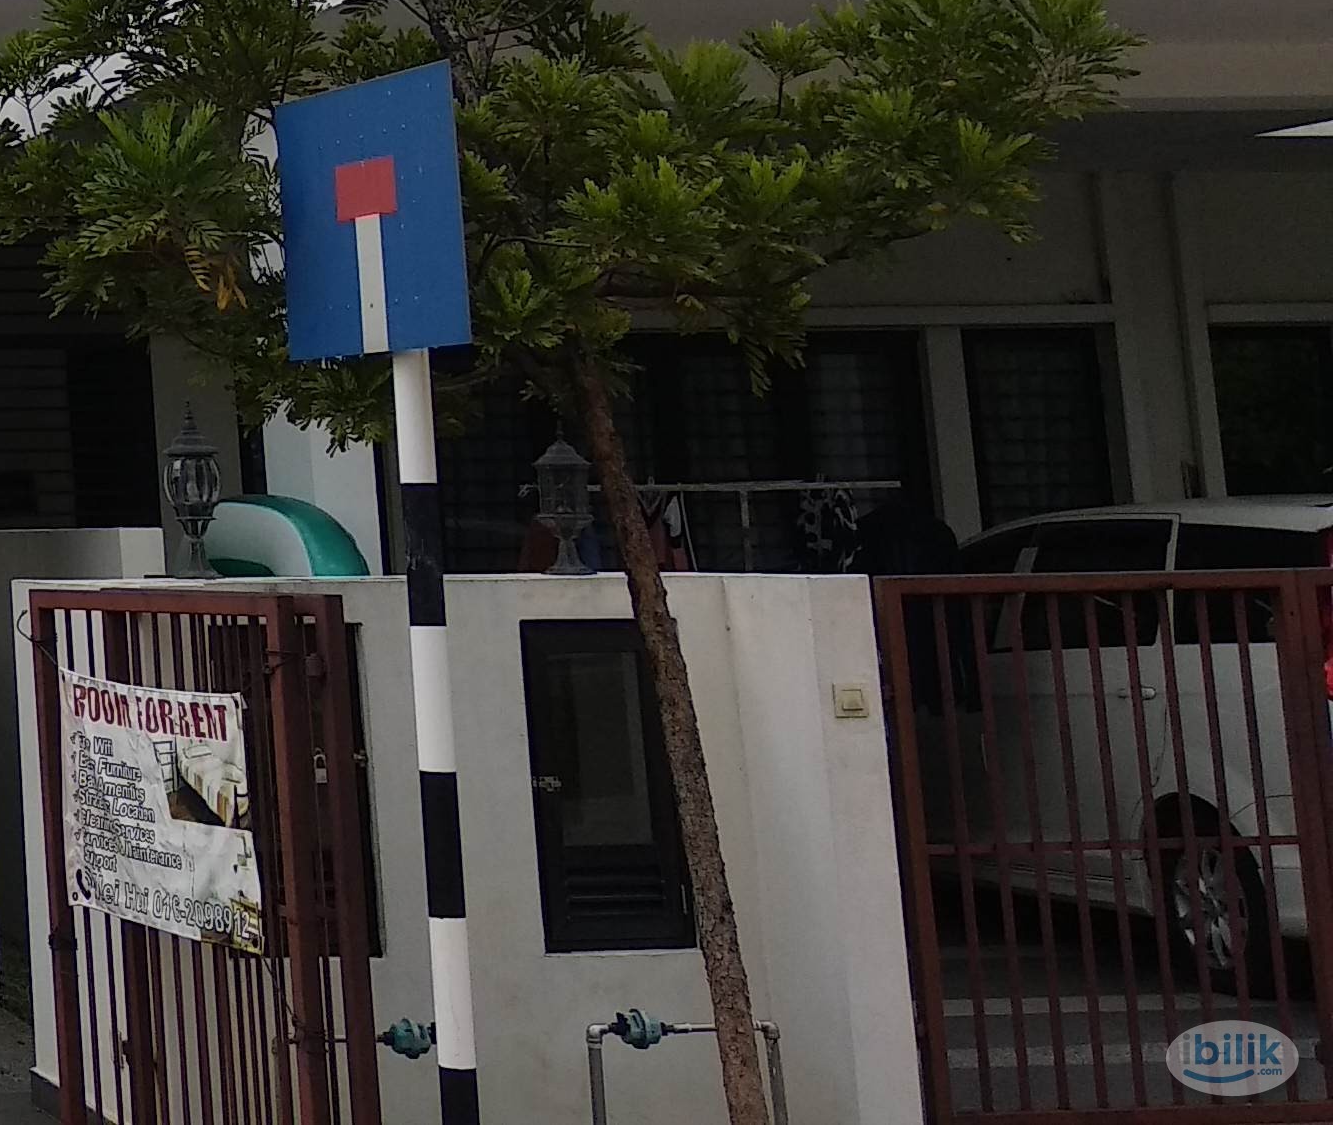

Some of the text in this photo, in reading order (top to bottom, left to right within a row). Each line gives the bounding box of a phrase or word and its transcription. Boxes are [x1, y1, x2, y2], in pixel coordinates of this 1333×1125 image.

[72, 683, 228, 742] ROOM FOR RENT
